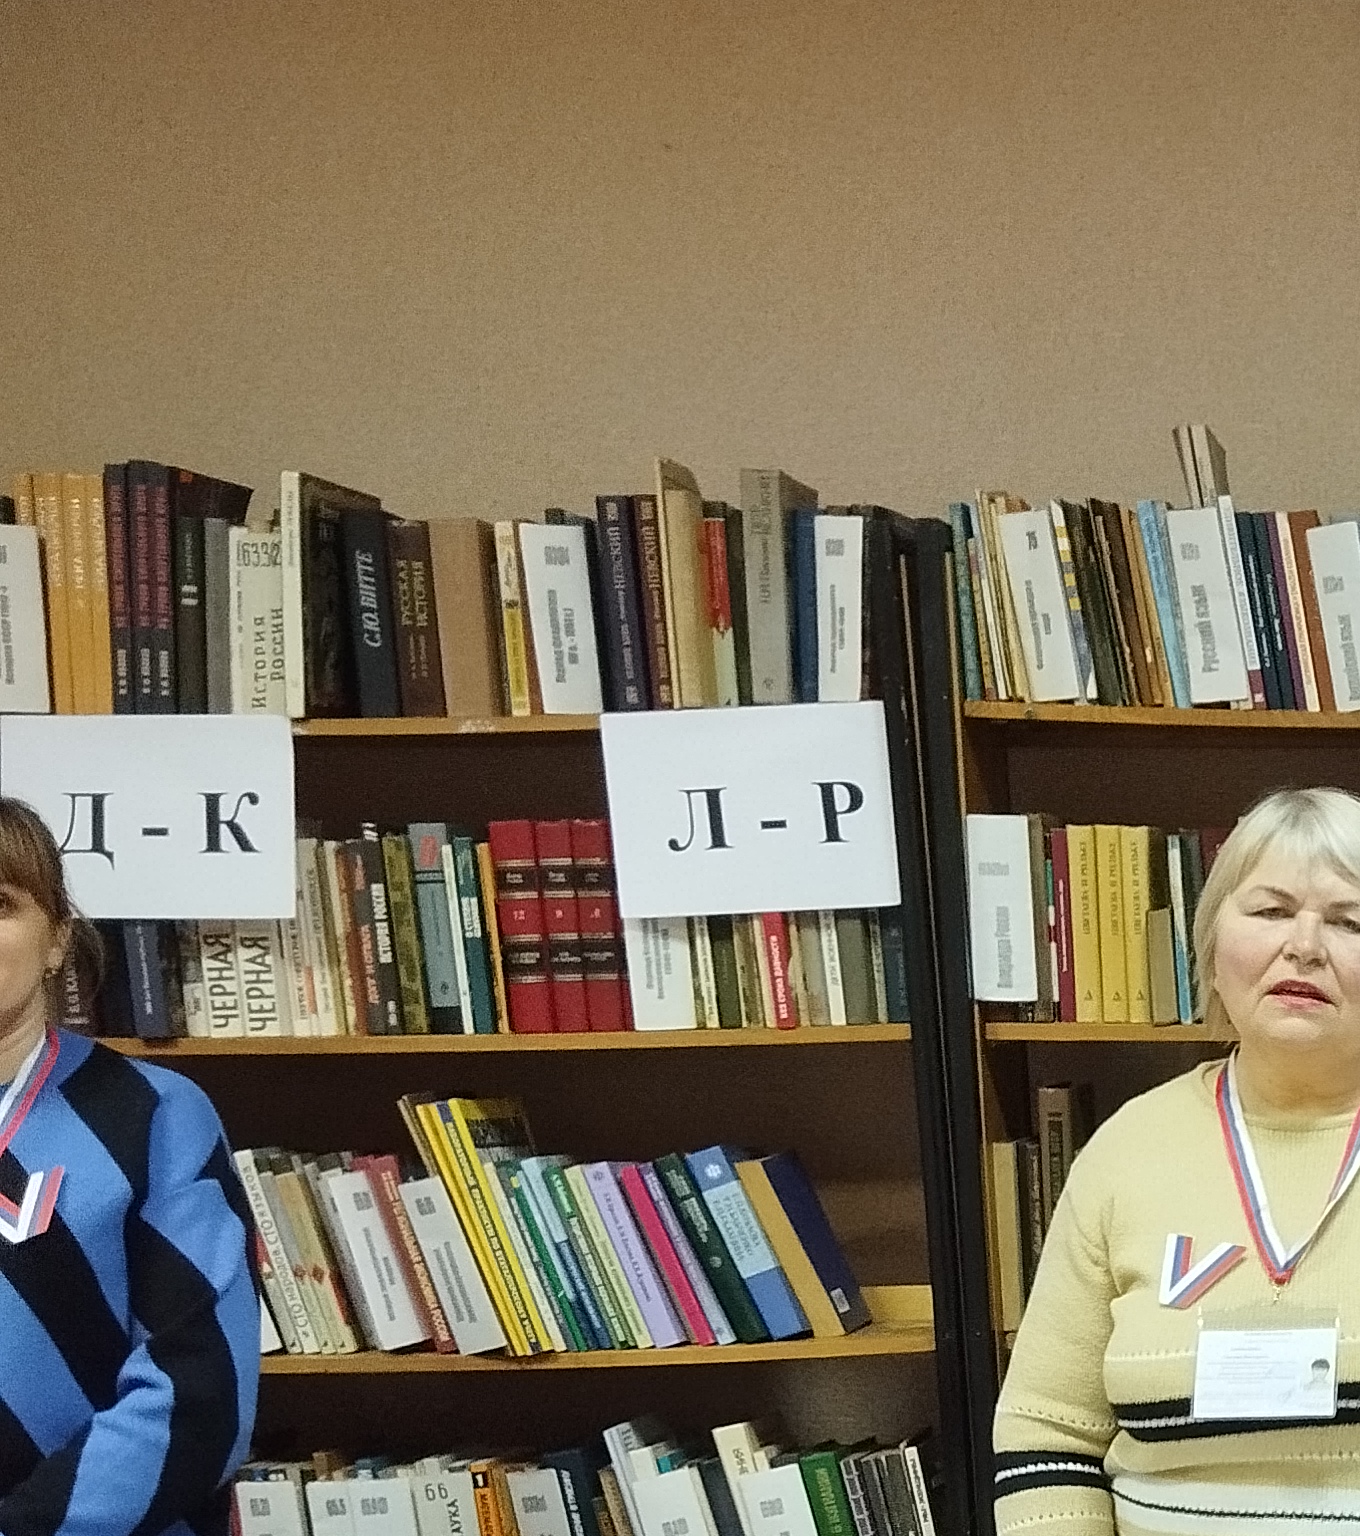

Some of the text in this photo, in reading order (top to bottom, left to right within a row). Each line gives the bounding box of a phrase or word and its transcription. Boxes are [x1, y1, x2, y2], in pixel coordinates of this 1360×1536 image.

[60, 791, 114, 869] Д
[199, 791, 260, 854] К
[668, 787, 735, 852] Л
[812, 781, 864, 844] Р
[203, 932, 238, 1029] ЧЕРНАЯ
[239, 935, 278, 1032] ЧЕРНАЯ
